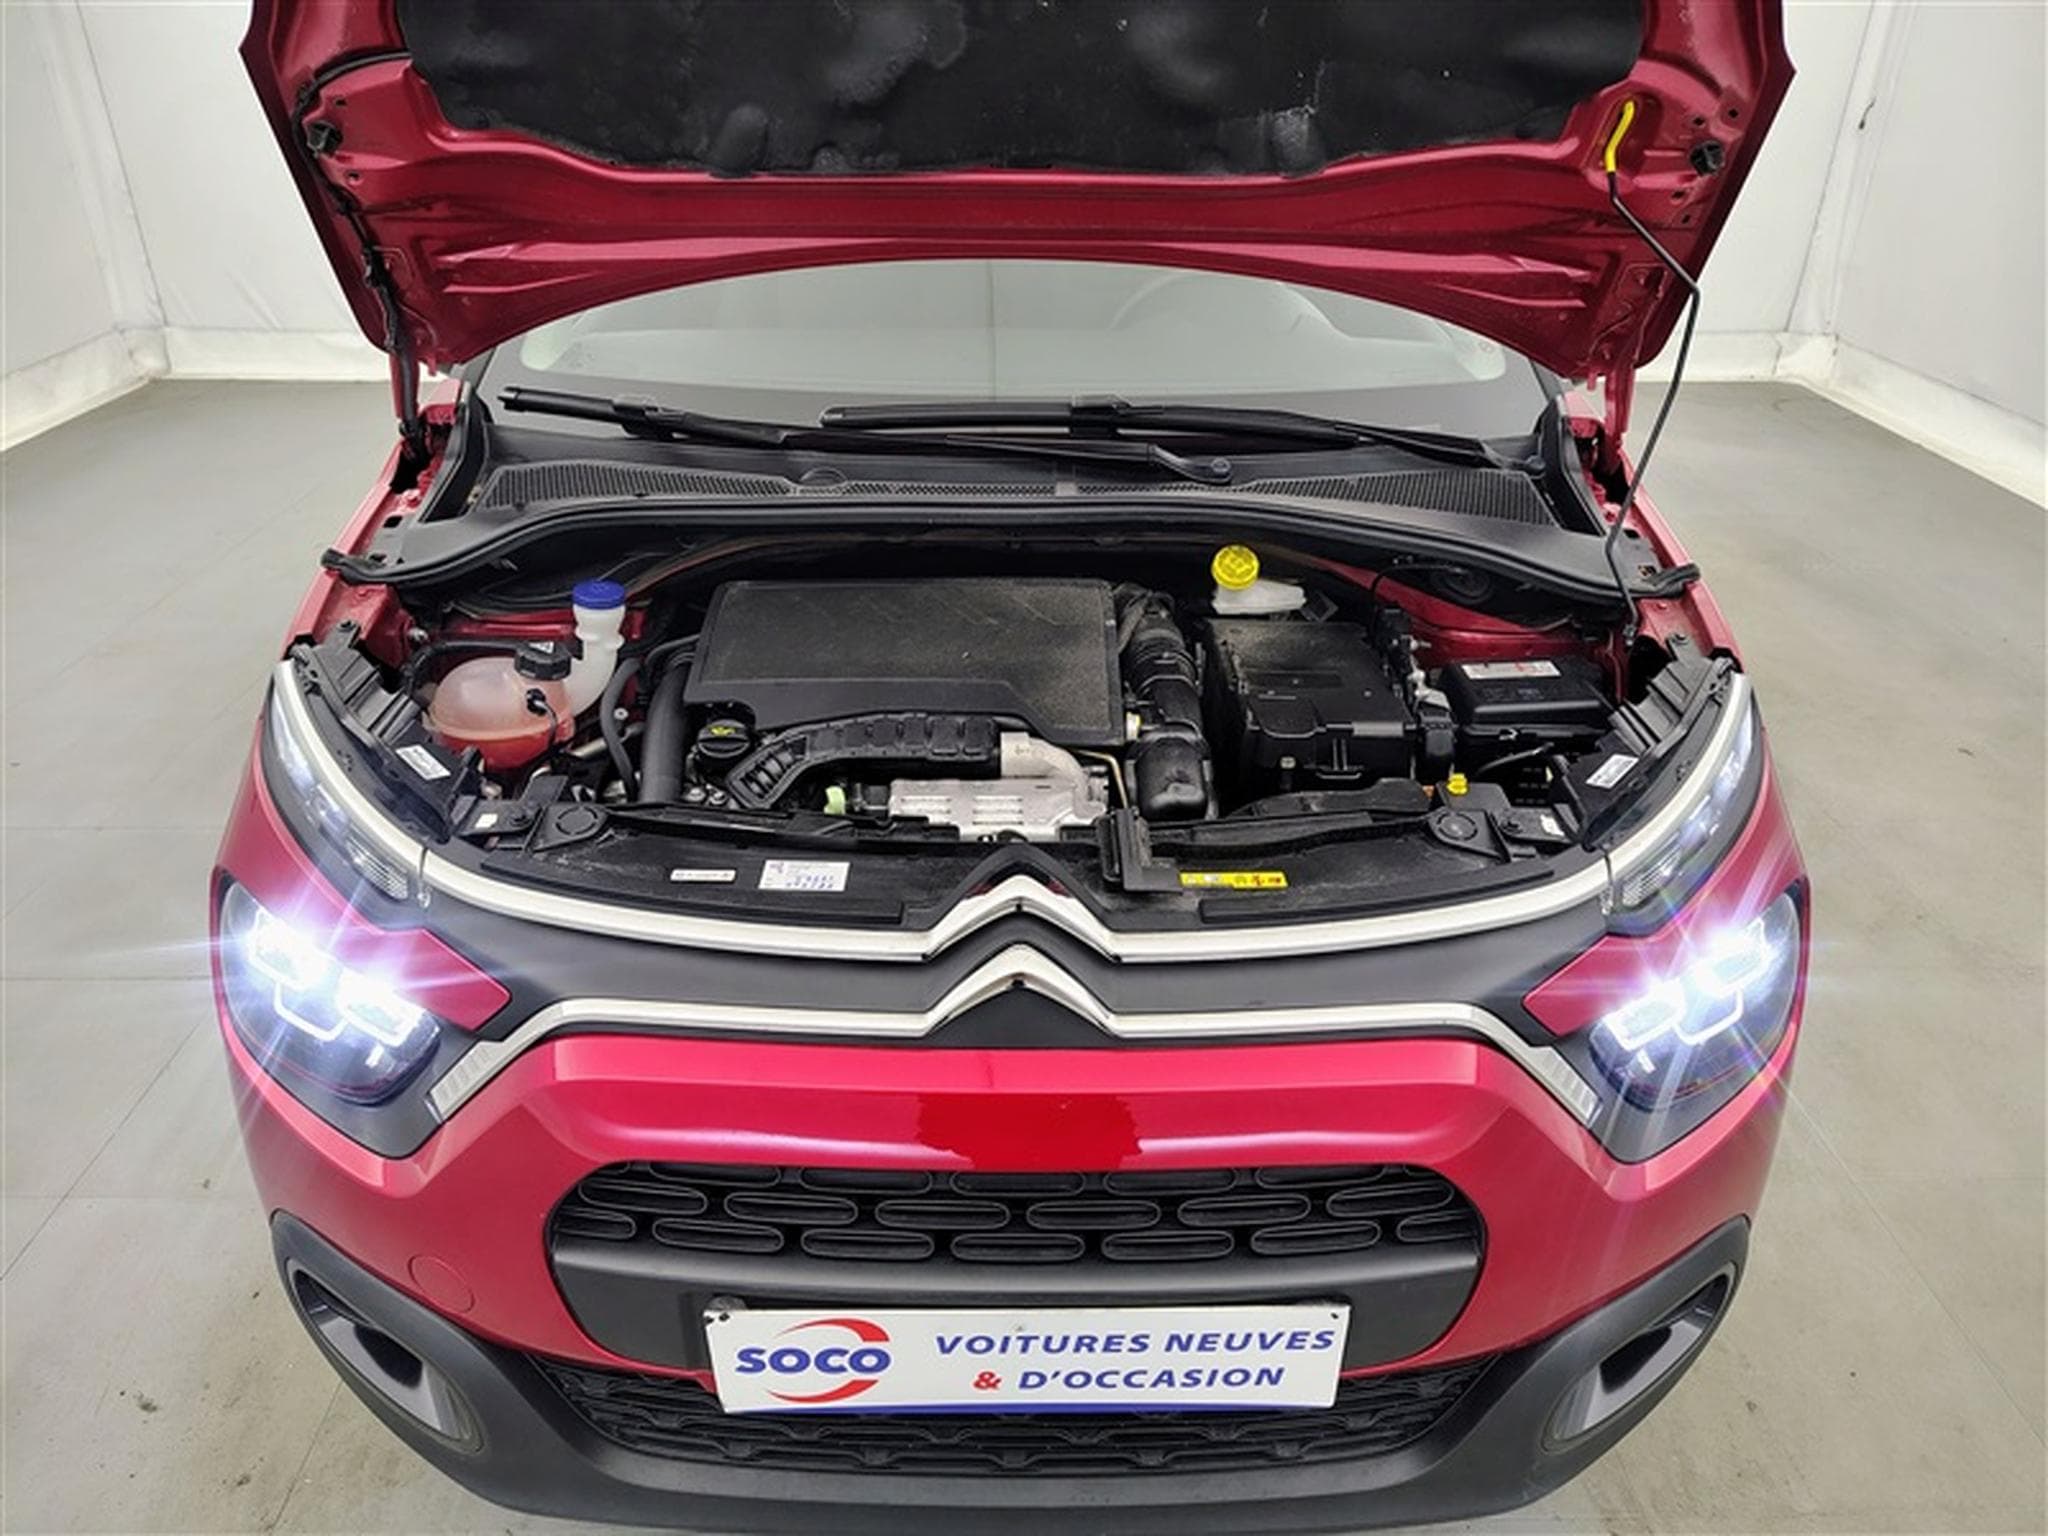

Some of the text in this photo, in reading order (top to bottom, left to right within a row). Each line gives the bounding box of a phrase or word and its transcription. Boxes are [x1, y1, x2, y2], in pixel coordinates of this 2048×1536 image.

[934, 1329, 1335, 1356] VOITURES NEUVES
[735, 1345, 892, 1376] SOCO
[972, 1366, 1285, 1392] & D'OCCASION
